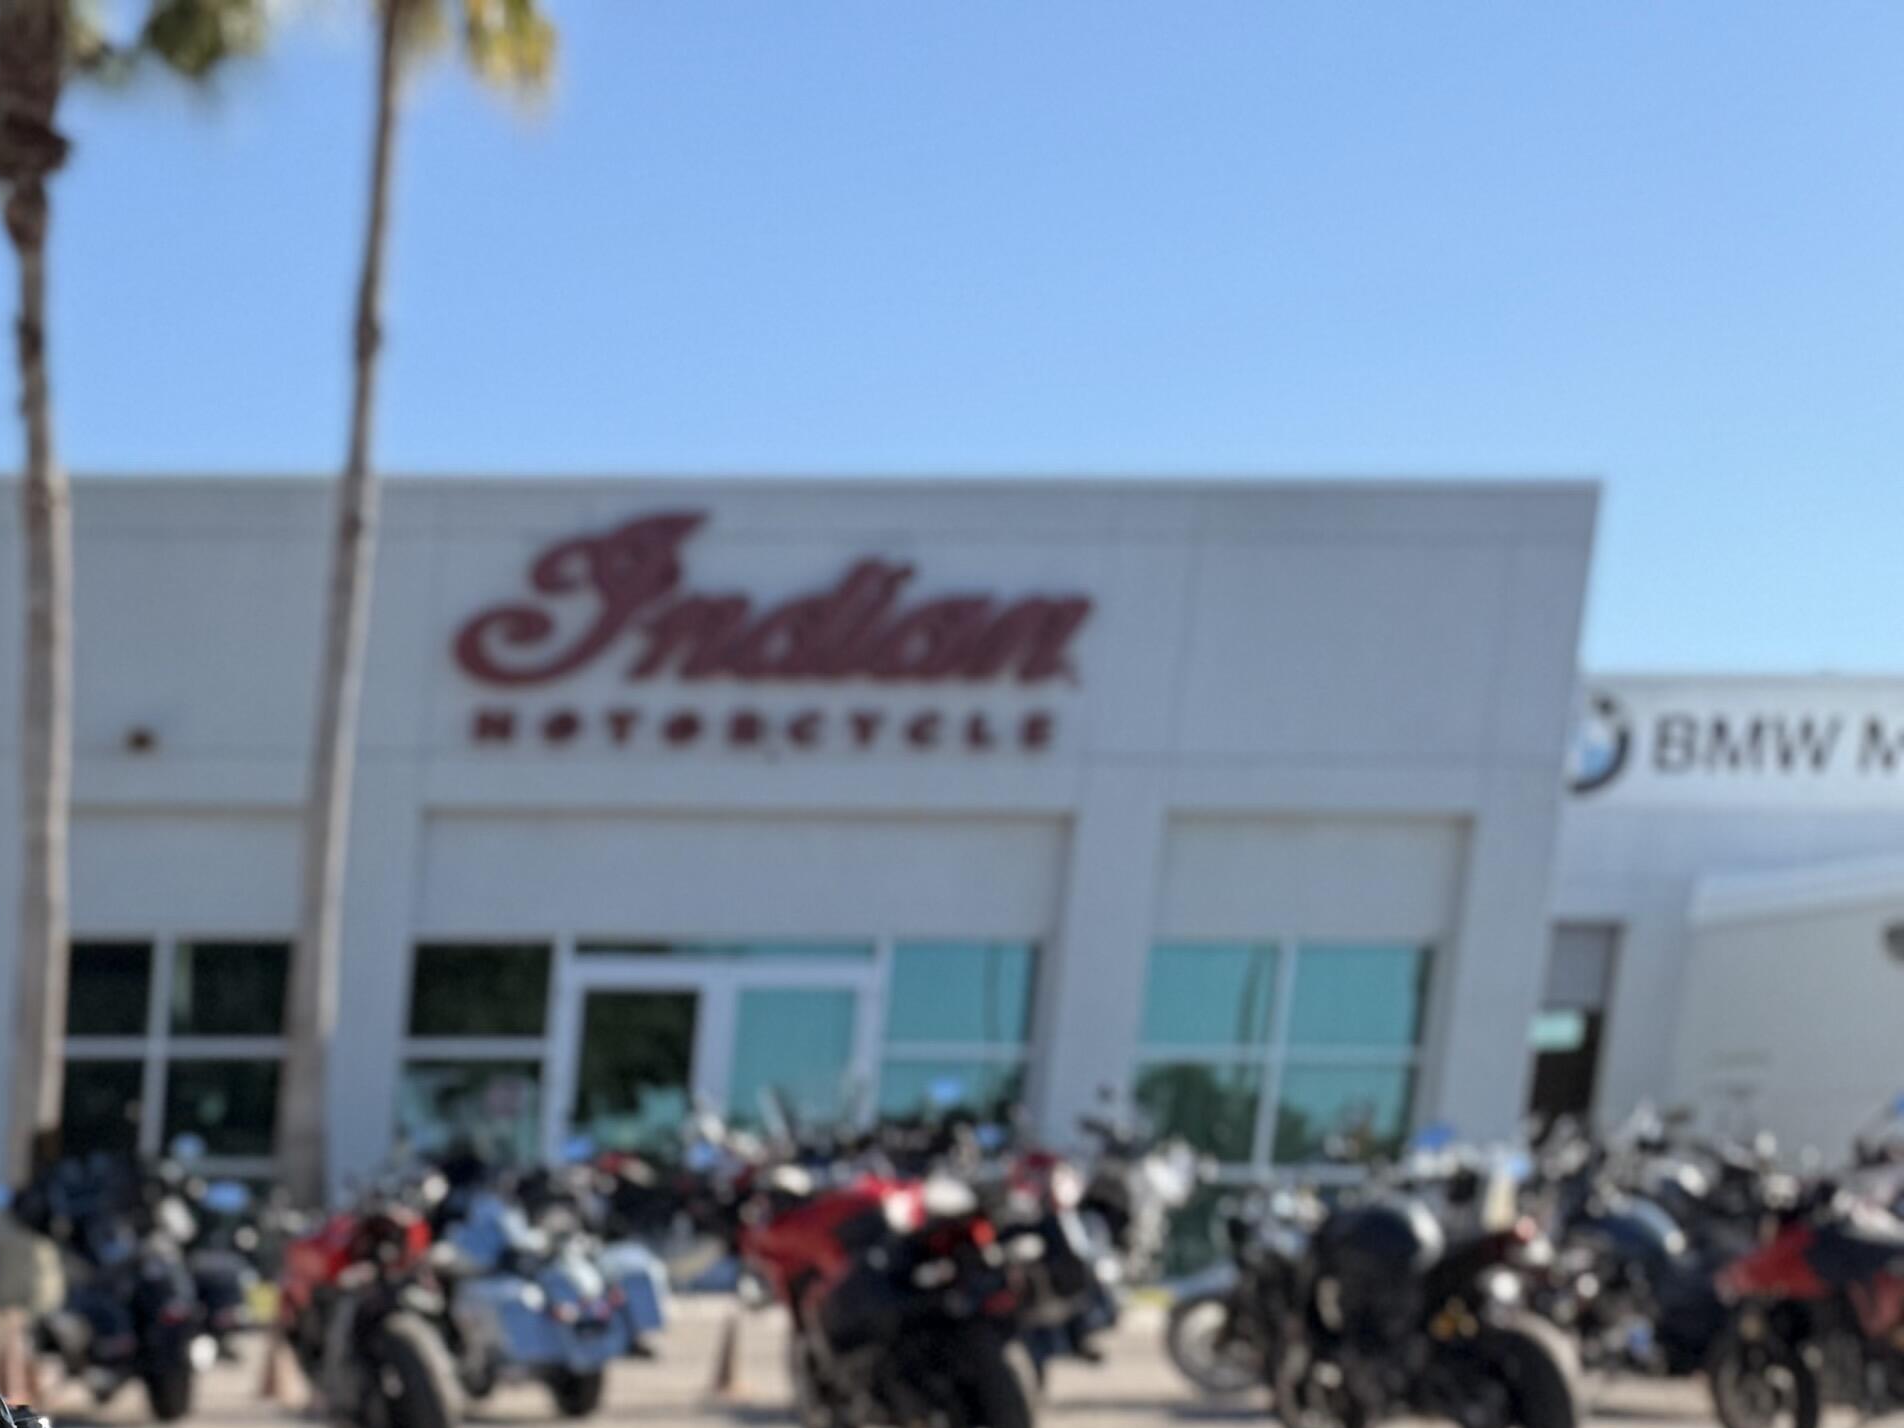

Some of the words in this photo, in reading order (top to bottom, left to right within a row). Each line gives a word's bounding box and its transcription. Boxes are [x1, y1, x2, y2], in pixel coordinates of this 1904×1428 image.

[452, 508, 1094, 686] Indian
[470, 710, 1056, 750] MOTORCYCLE
[1654, 713, 1846, 776] BMW
